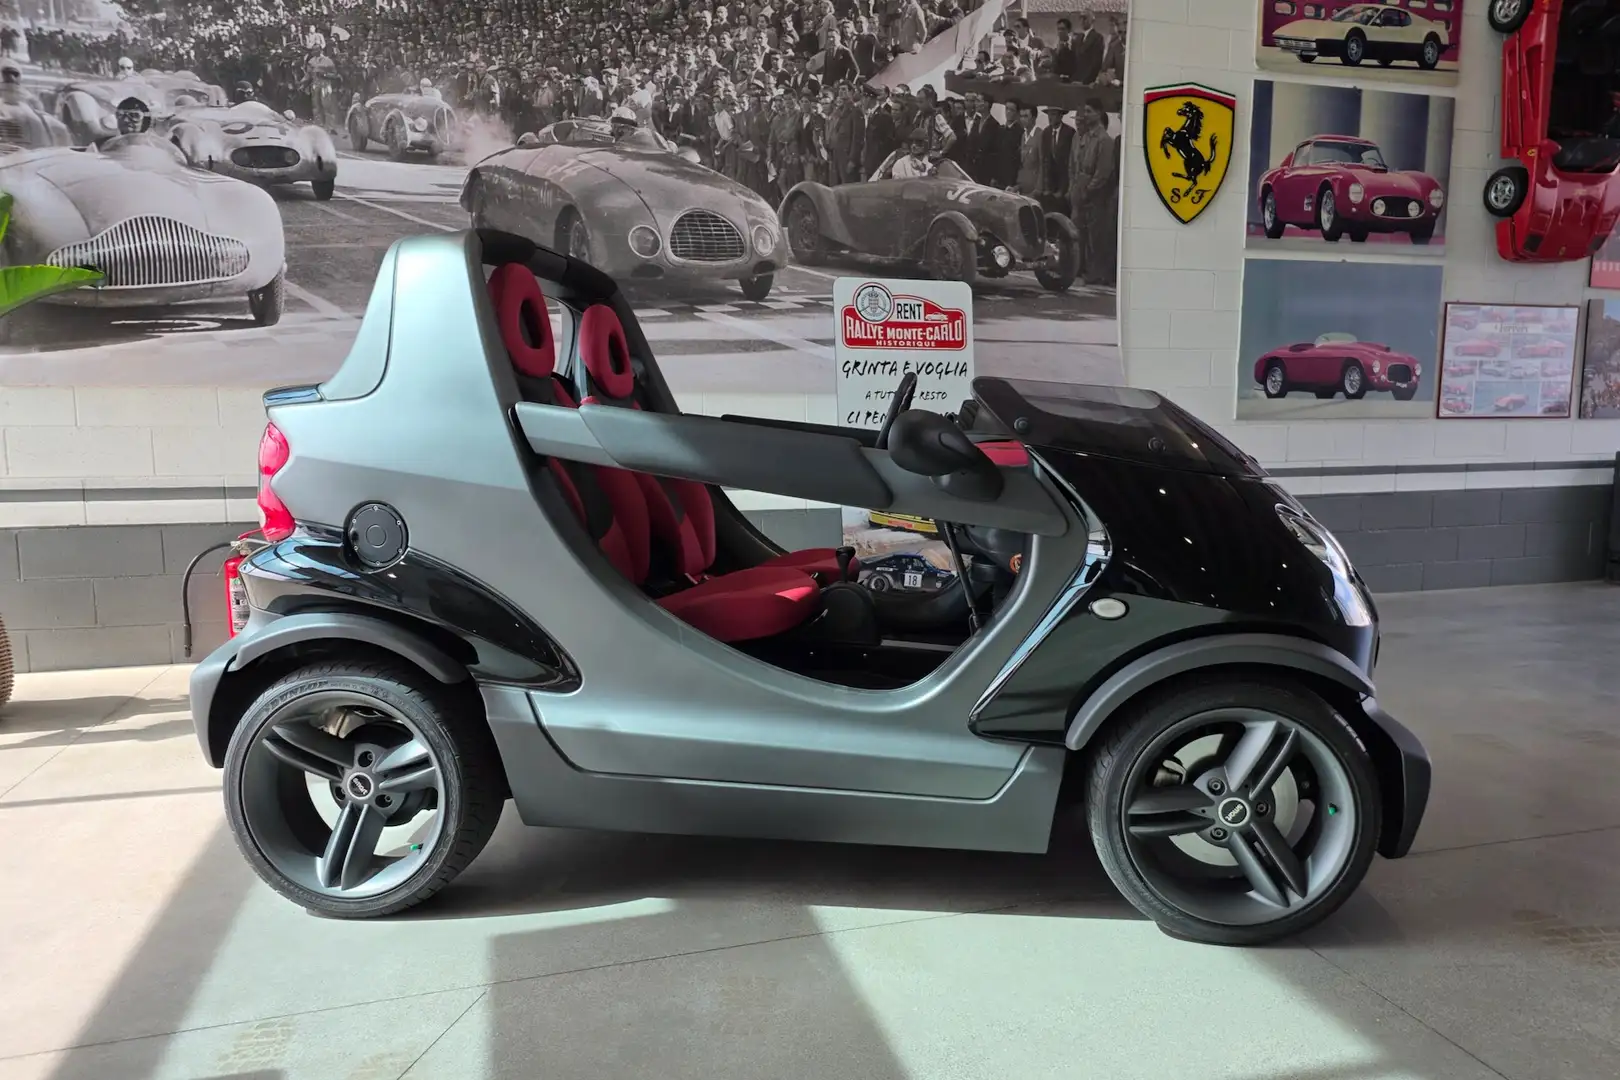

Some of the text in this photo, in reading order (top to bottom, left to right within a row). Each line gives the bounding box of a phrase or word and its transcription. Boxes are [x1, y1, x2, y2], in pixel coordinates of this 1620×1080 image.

[1170, 187, 1211, 205] S F
[896, 303, 922, 320] RENT
[846, 316, 962, 341] RALLYE MONTE-CARLO
[842, 360, 898, 379] GRINTA
[915, 360, 968, 380] VOGLIA
[865, 391, 871, 400] A
[920, 390, 948, 400] RESTO
[847, 411, 861, 424] CI
[908, 575, 918, 586] 18
